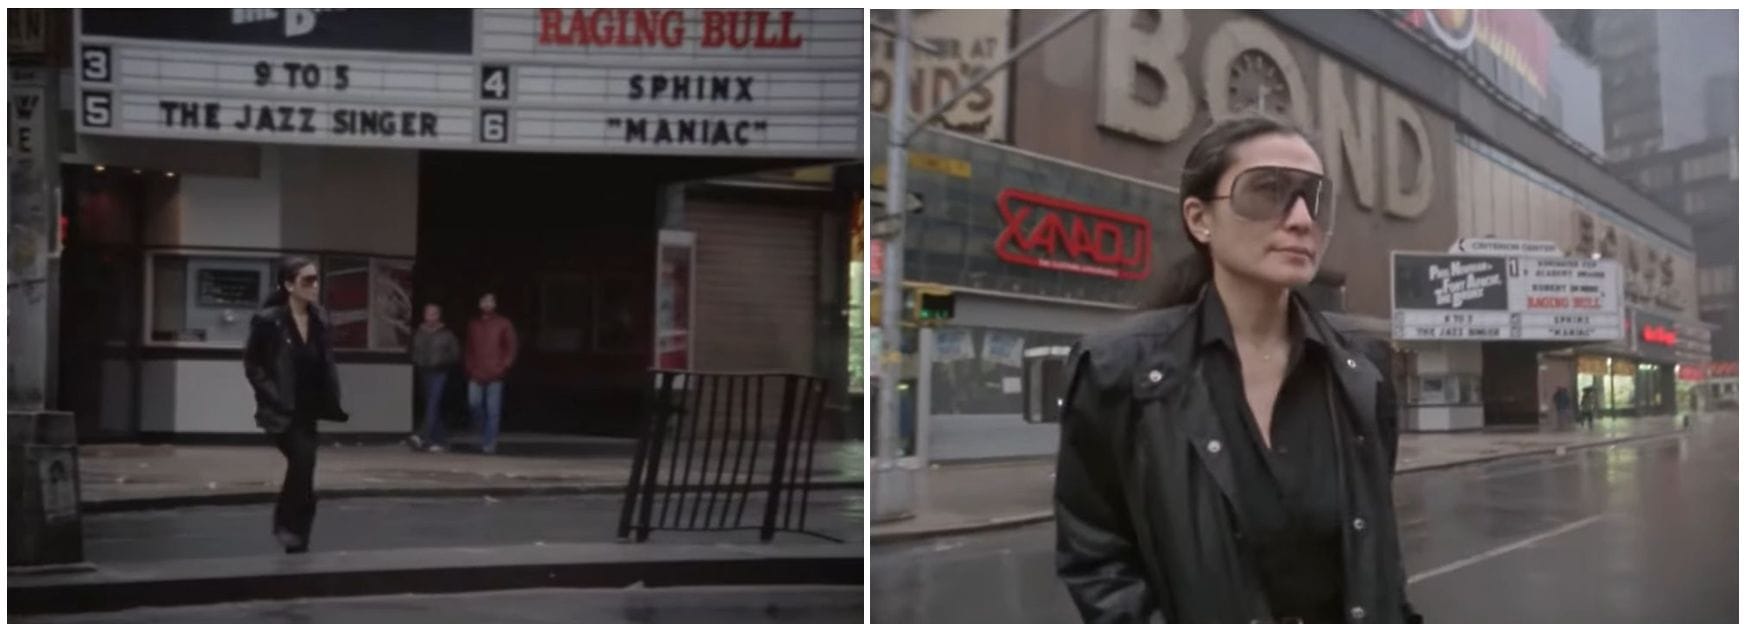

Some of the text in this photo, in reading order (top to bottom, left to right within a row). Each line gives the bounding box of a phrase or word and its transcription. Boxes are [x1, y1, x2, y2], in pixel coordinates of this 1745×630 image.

[538, 9, 804, 49] RAGING BULL
[84, 49, 109, 81] 3
[254, 61, 350, 90] 9 TO 5
[483, 71, 505, 98] 4
[628, 75, 754, 102] SPHINX
[85, 95, 109, 127] 5
[159, 101, 438, 137] THE JAZZ SINGER
[1095, 9, 1435, 220] BOND
[483, 113, 505, 141] 6
[607, 117, 768, 146] "MANIAC"
